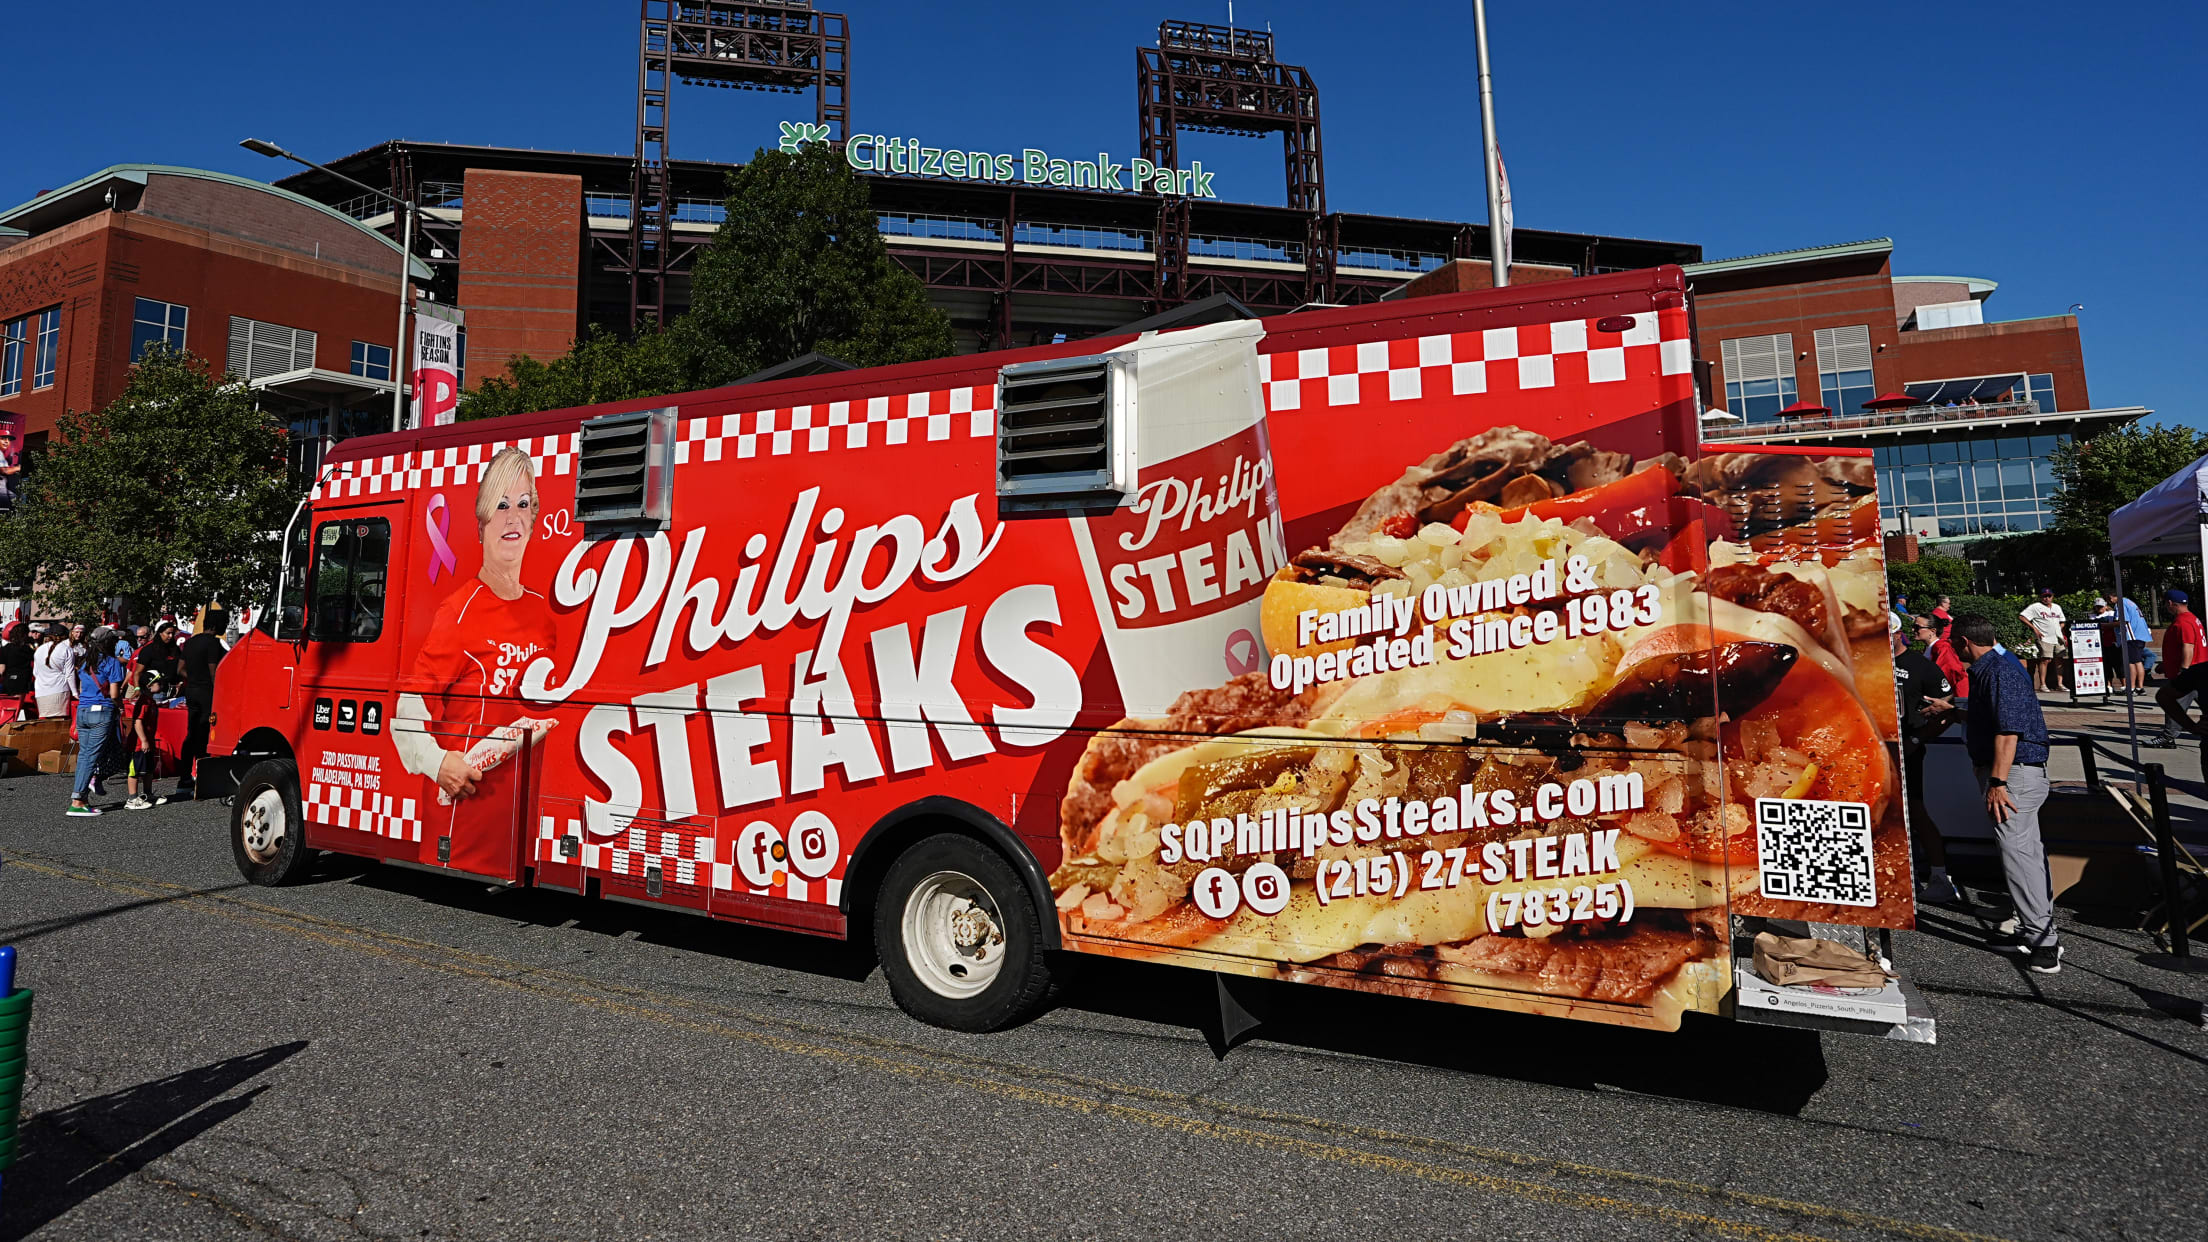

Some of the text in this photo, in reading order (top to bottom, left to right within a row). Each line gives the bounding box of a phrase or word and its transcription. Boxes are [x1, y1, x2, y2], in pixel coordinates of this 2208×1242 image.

[846, 134, 1216, 198] Citizens Bank Park
[542, 508, 573, 540] SQ
[1118, 448, 1273, 551] Philips
[520, 485, 1005, 703] Philips
[1299, 554, 1600, 647] Family Owned &
[1269, 584, 1663, 696] Operated Since 1983
[315, 714, 330, 724] Eats
[316, 704, 331, 714] Uber
[578, 584, 1083, 838] STEAKS
[311, 766, 381, 791] PHILADELPHIA, PA 19145
[321, 750, 382, 773] 23RD PASSYUNK AVE.
[472, 753, 497, 771] TEAKS
[1160, 770, 1645, 864] SQPhilipsSteaks.com
[1315, 828, 1621, 905] (215) 27-STEAK
[1486, 880, 1635, 934] (78325)
